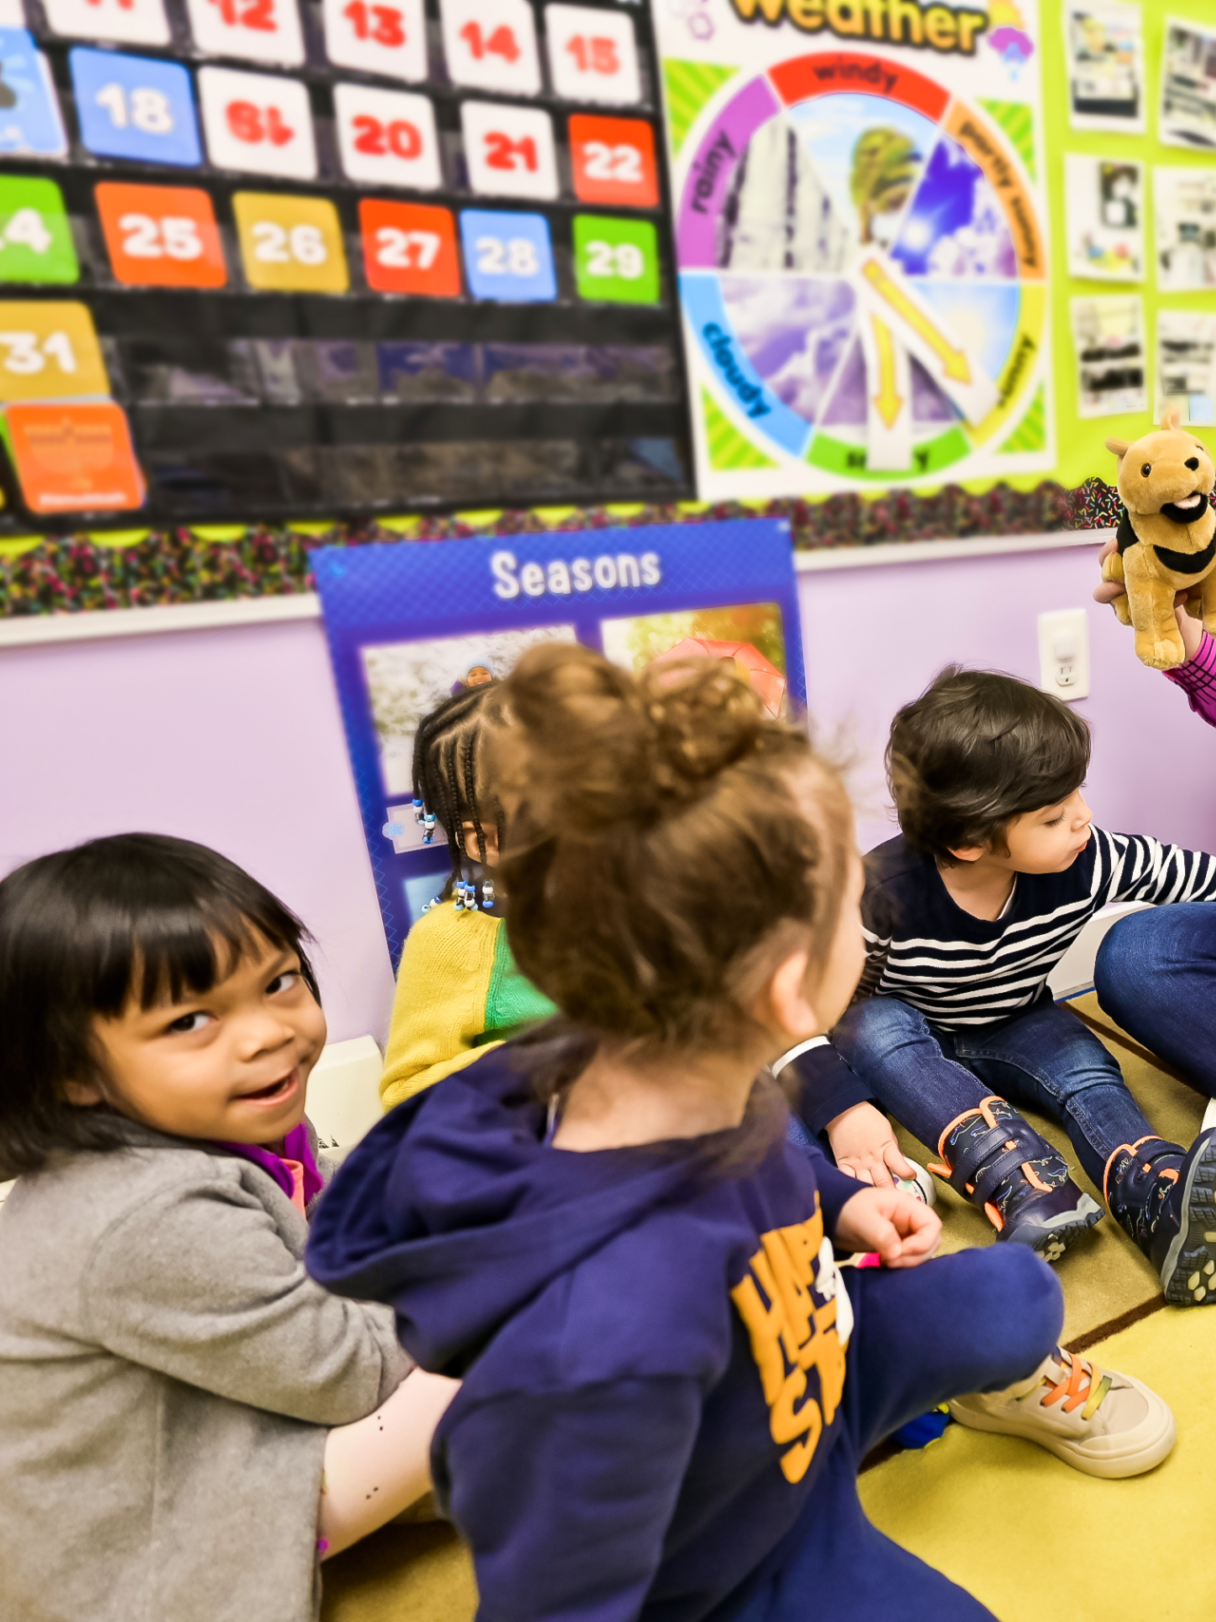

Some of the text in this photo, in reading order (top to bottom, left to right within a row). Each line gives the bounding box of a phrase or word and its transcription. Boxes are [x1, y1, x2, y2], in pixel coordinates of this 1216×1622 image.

[210, 0, 278, 32] 12
[343, 0, 406, 48] 13
[459, 20, 520, 63] 14
[565, 34, 621, 75] 15
[812, 57, 898, 95] windy
[96, 83, 174, 134] 18
[351, 115, 422, 160] 20
[483, 132, 538, 172] 21
[582, 142, 644, 183] 22
[691, 130, 737, 215] rainy
[0, 206, 52, 254] 4
[118, 213, 203, 259] 25
[250, 221, 328, 265] 26
[375, 227, 441, 270] 27
[475, 237, 540, 276] 28
[584, 240, 645, 279] 29
[0, 331, 76, 374] 31
[702, 321, 772, 420] cloudy
[846, 449, 930, 473] sny
[490, 551, 661, 598] Seasons
